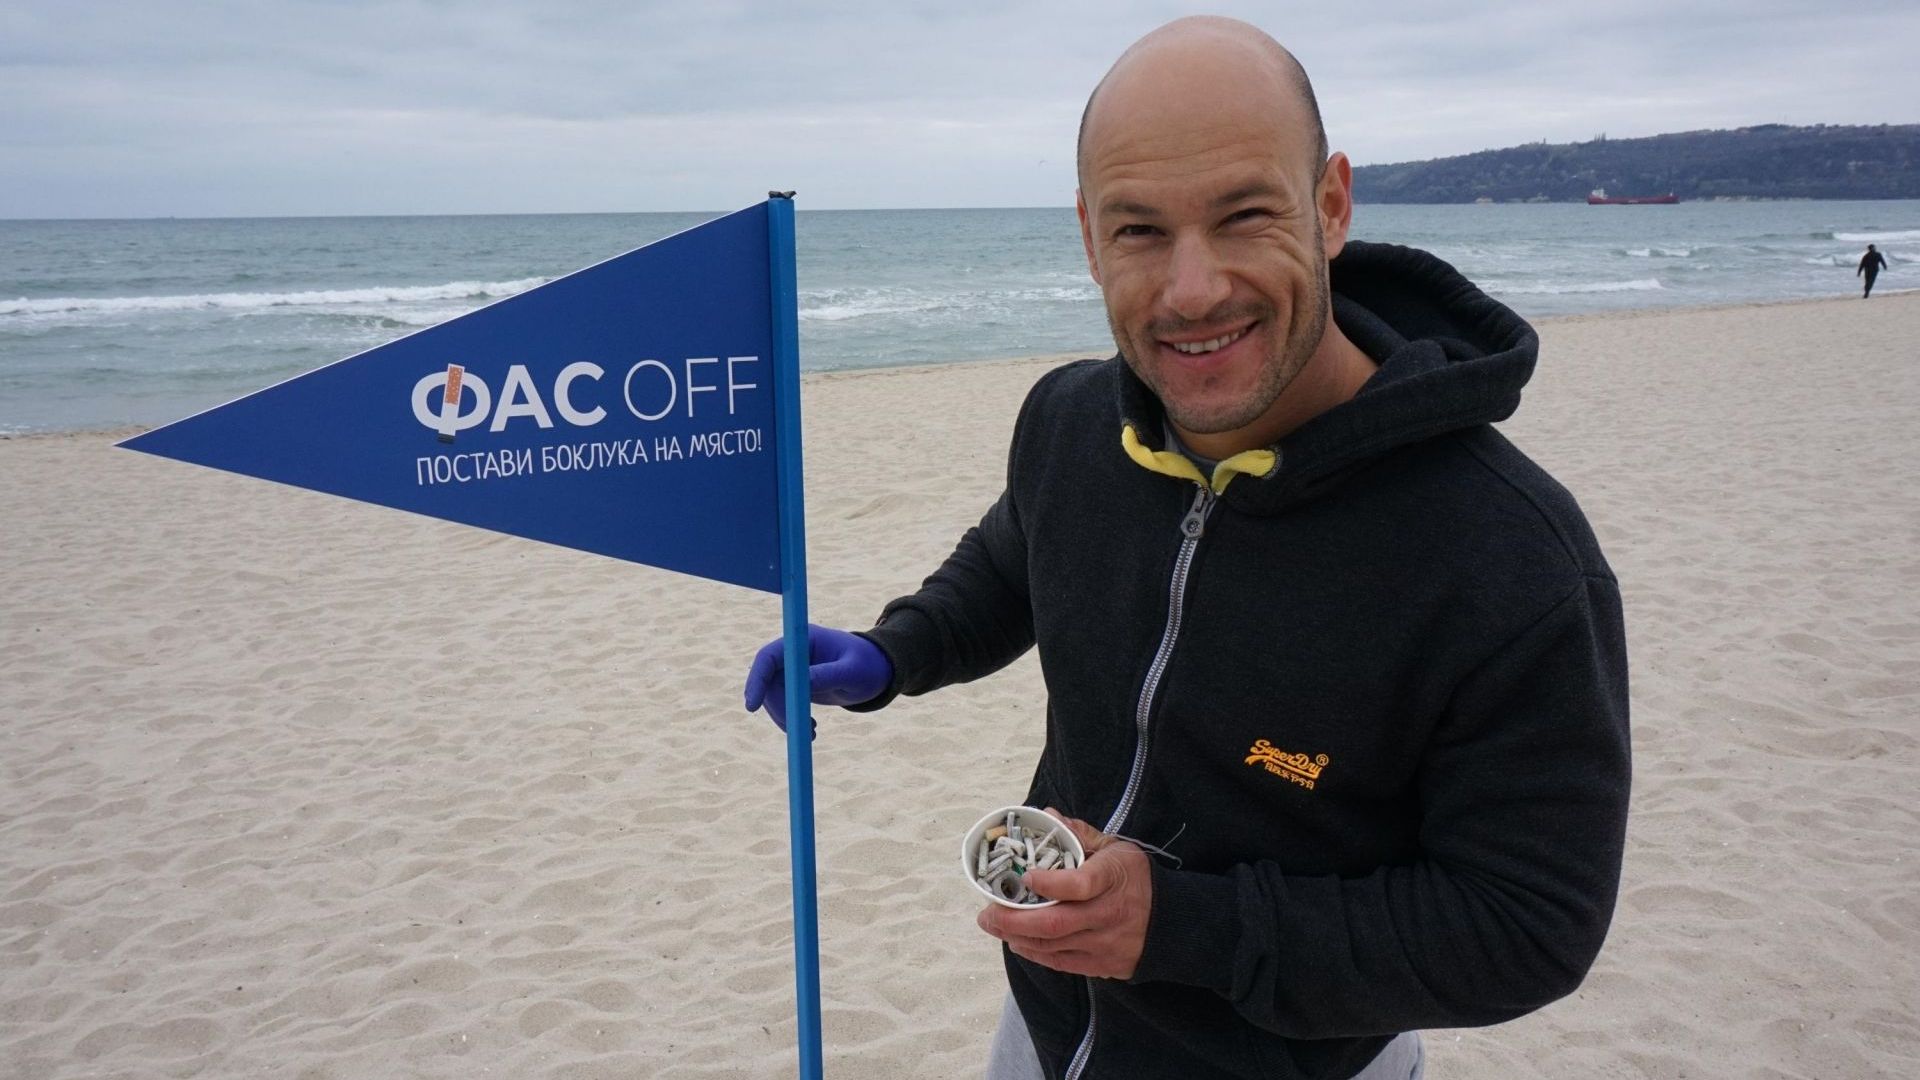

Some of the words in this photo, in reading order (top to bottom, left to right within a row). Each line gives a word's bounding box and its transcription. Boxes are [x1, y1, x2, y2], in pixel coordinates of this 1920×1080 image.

[411, 361, 607, 443] ФАС
[623, 355, 759, 421] OFF
[416, 448, 534, 485] ПОСТАВИ
[541, 439, 648, 472] БОКЛУКА
[654, 436, 683, 462] НА
[689, 428, 762, 458] МЯСТО!
